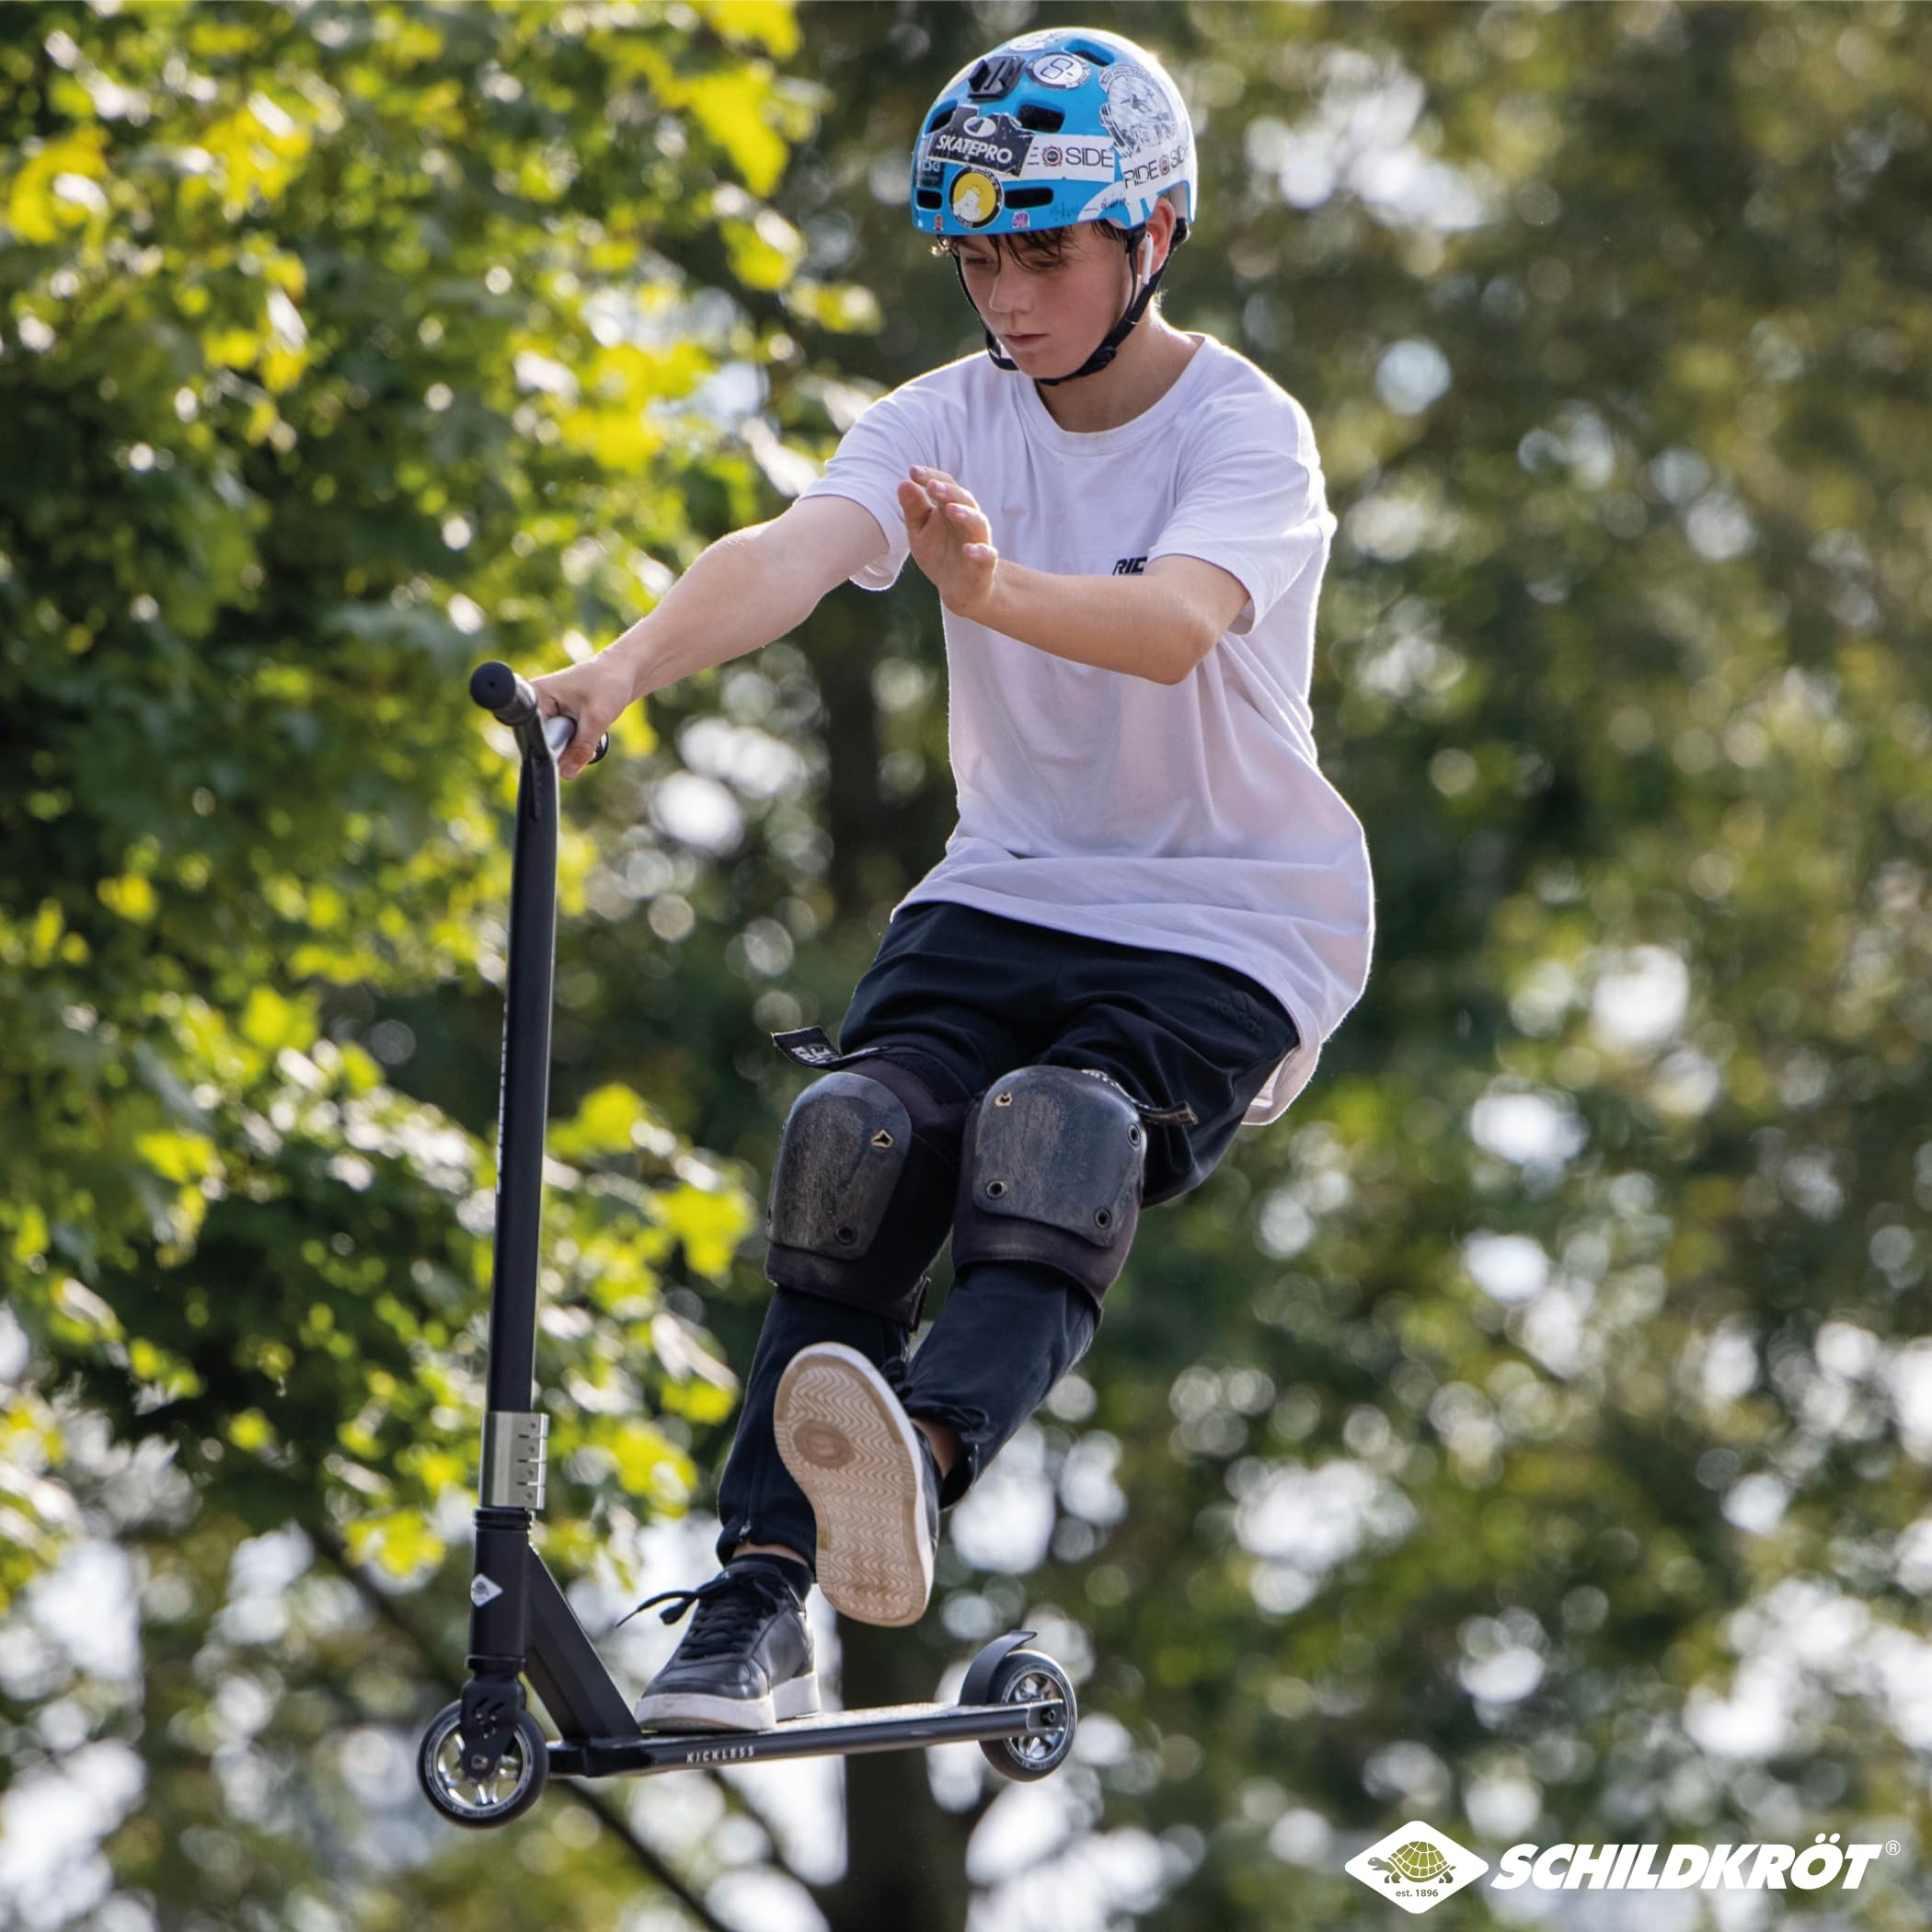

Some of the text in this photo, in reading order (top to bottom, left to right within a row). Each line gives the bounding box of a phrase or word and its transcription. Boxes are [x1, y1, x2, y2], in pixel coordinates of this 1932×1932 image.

[937, 134, 1013, 164] SKATEPRO
[1065, 146, 1113, 167] SIDE
[1123, 160, 1159, 190] RIDE
[686, 1744, 754, 1765] KICKLESS
